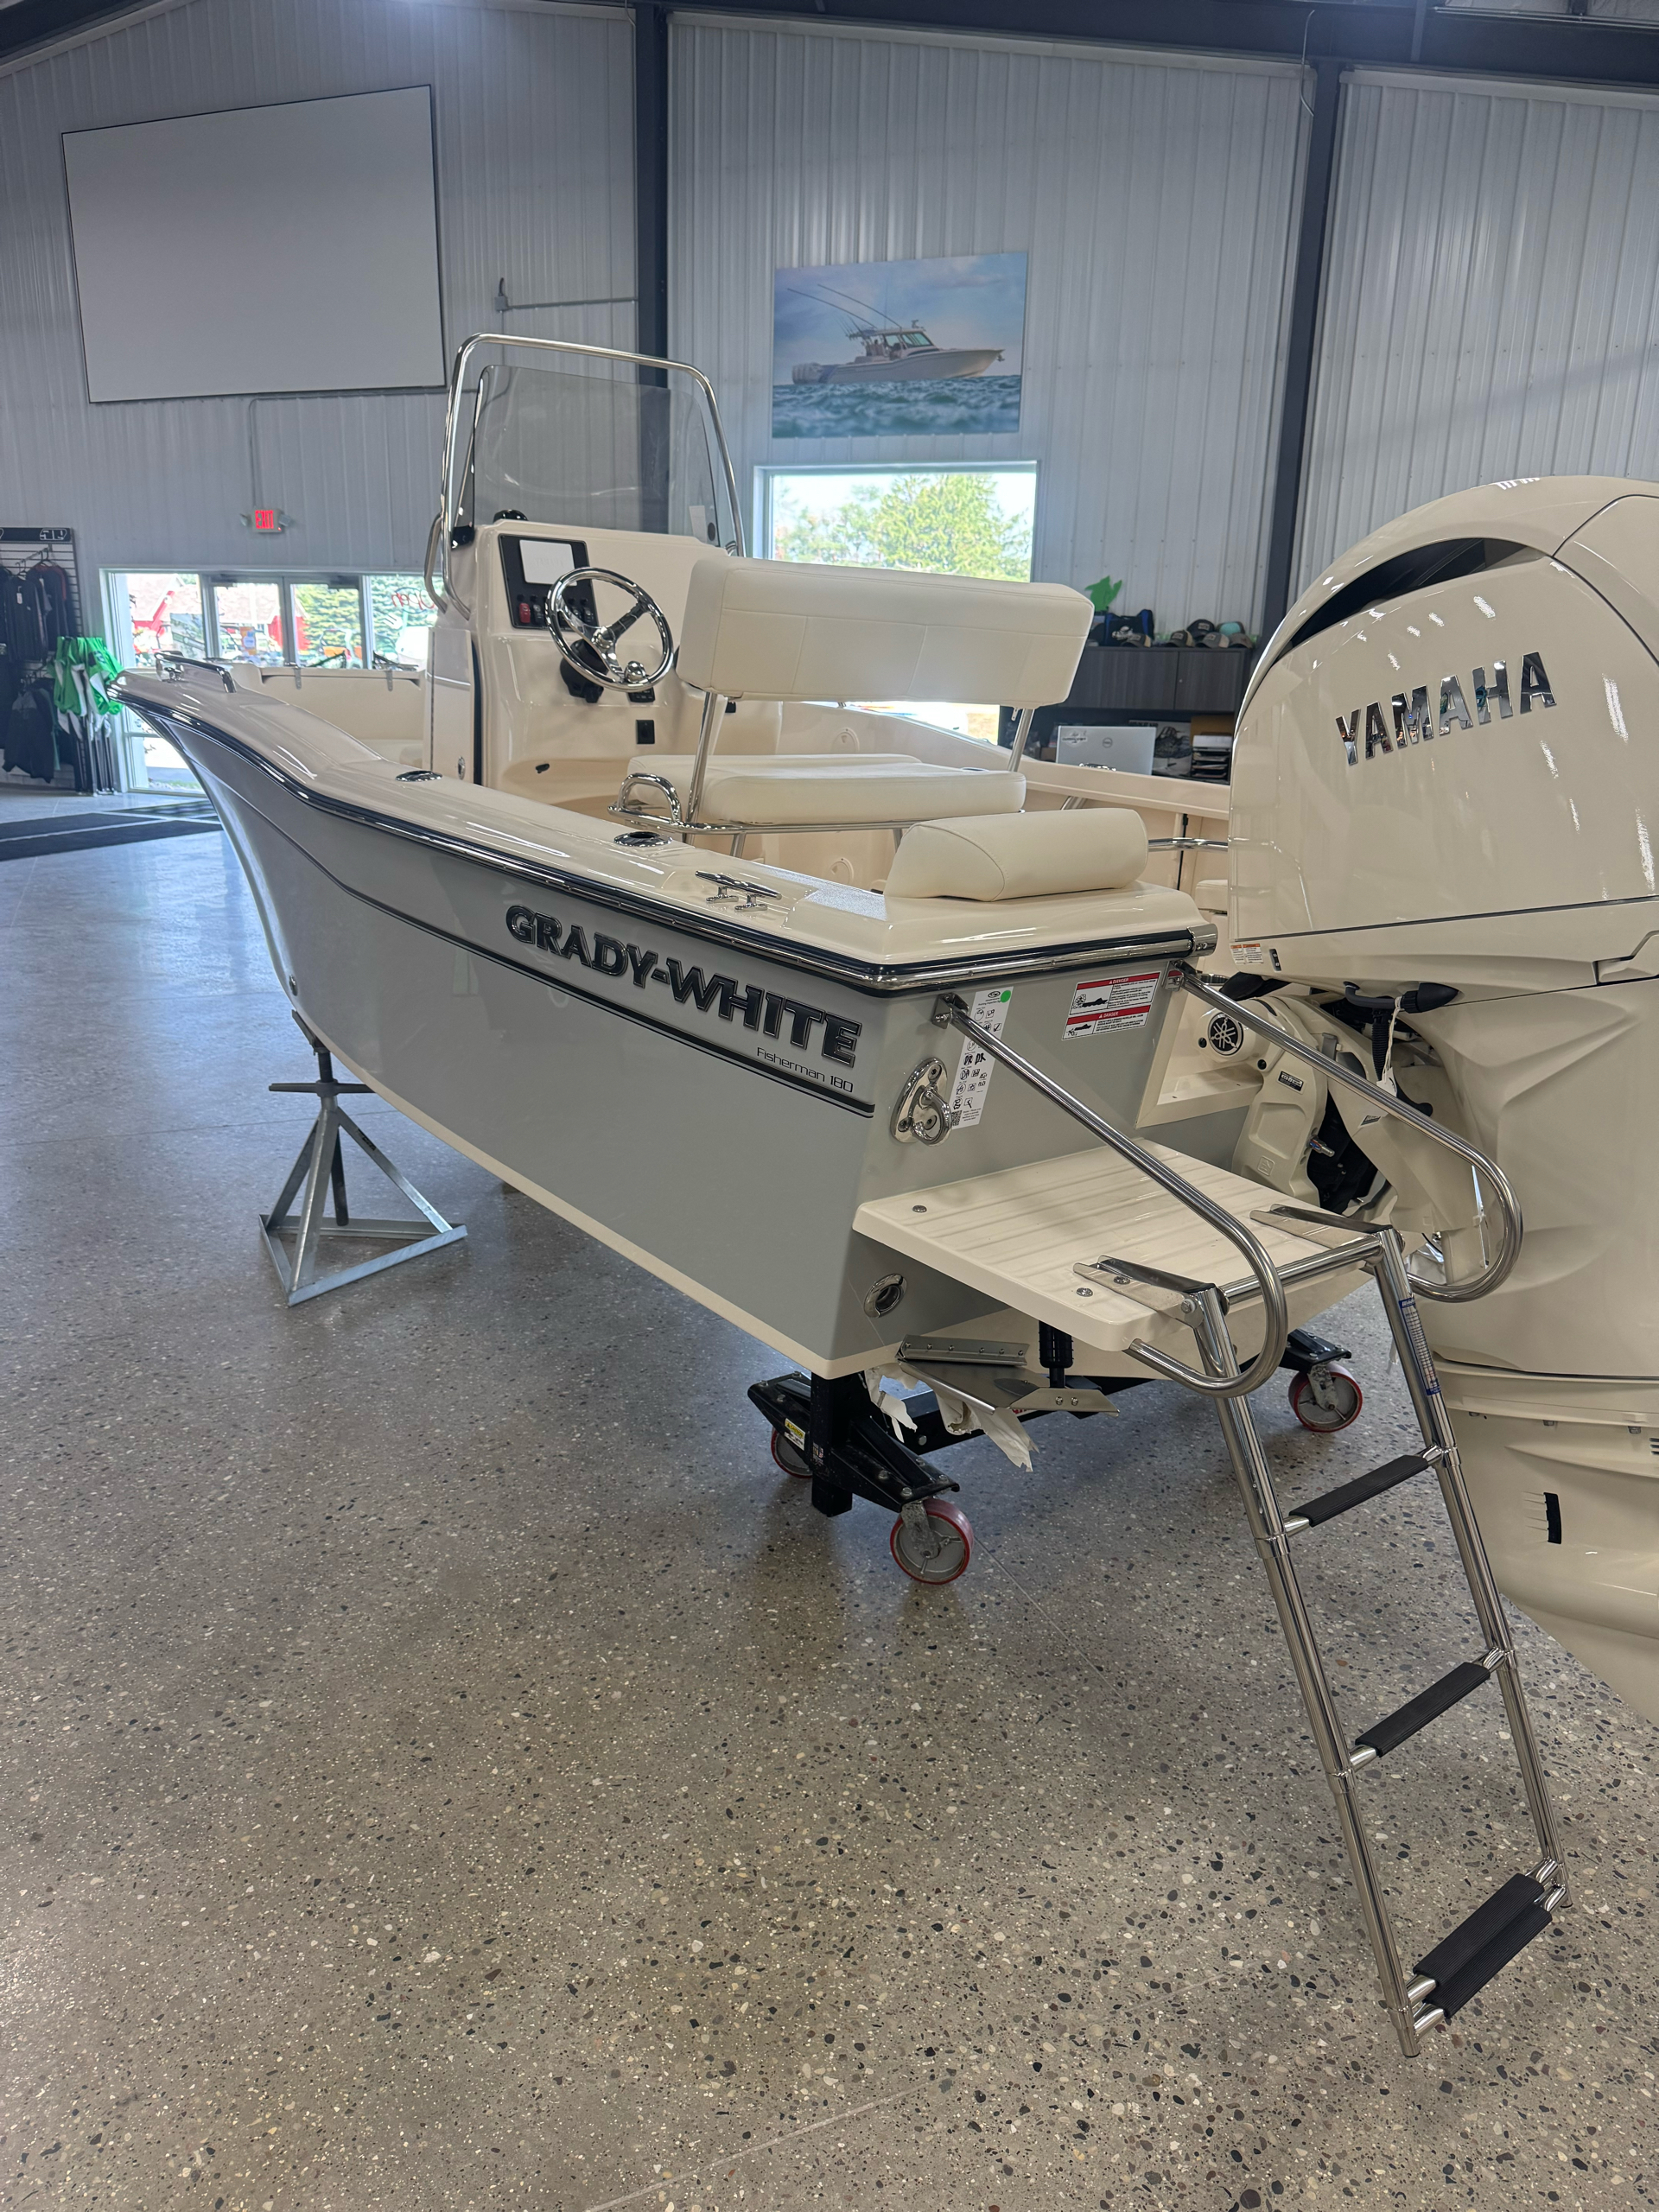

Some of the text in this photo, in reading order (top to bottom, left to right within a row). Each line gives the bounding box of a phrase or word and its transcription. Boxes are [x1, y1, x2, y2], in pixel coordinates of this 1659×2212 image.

[255, 510, 274, 529] EXIT
[1335, 652, 1557, 766] YAMAHA
[505, 905, 862, 1069] GRADY-WHITE
[757, 1046, 854, 1093] Fisherman 180
